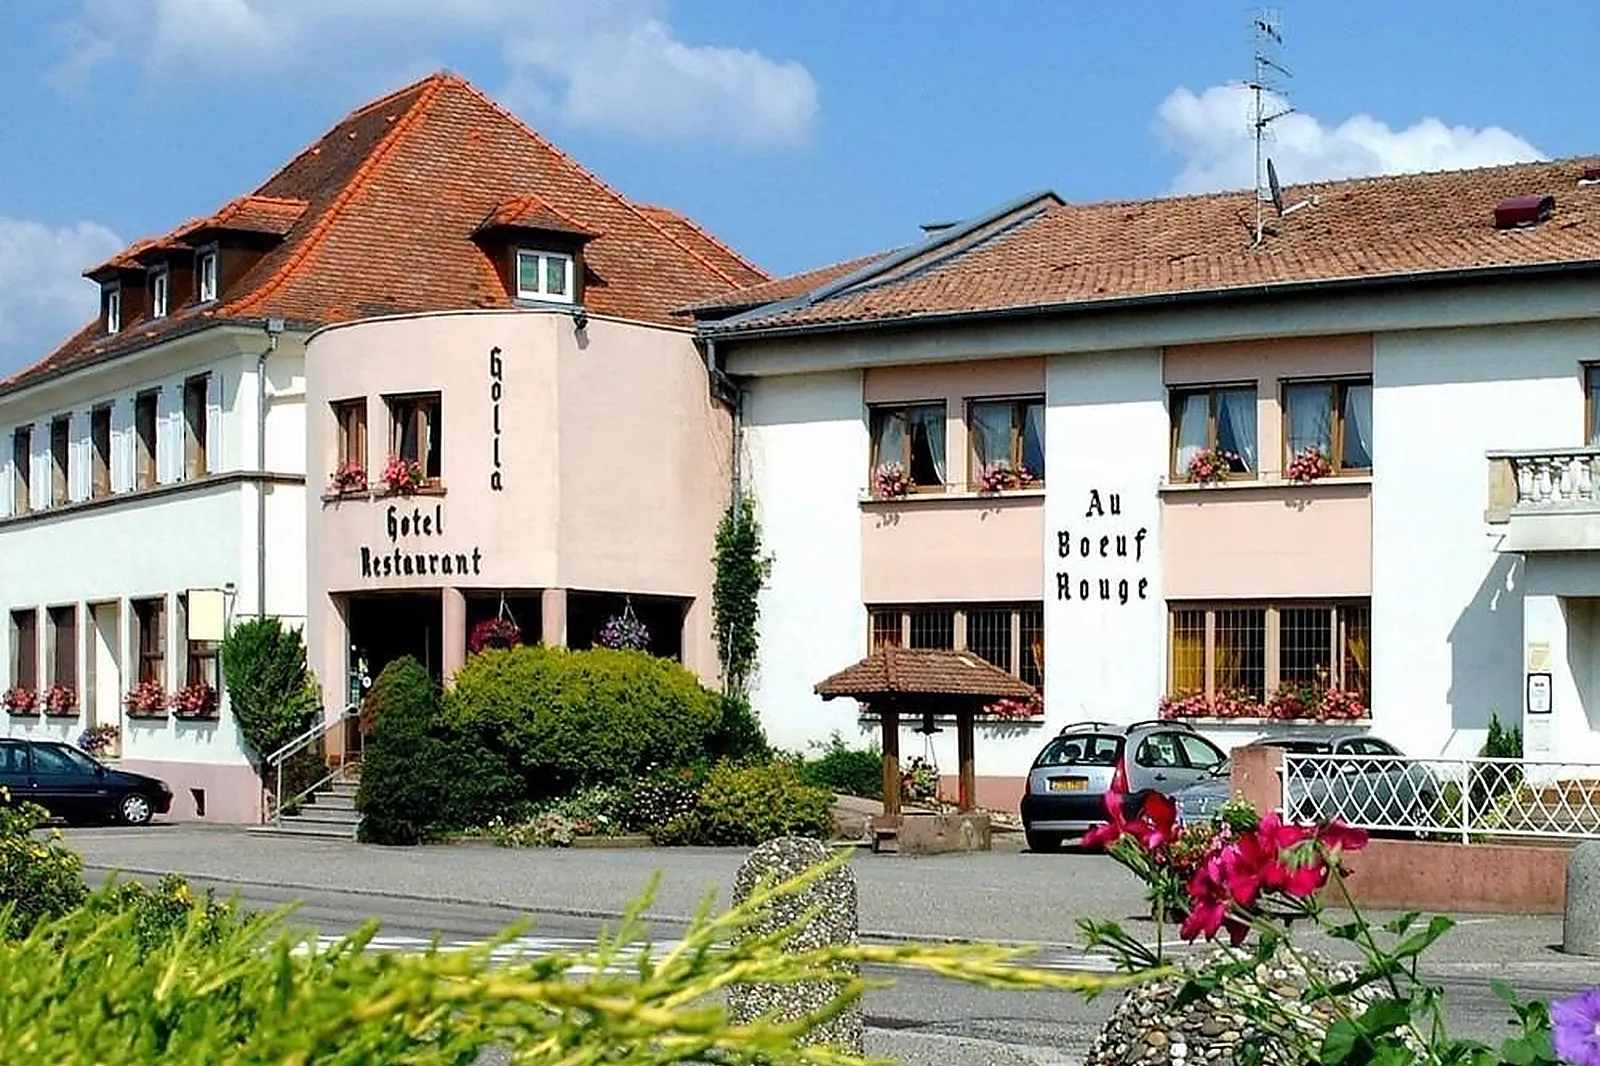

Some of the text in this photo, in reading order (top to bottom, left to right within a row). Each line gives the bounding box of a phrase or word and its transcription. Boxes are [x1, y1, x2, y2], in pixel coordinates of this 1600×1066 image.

[1085, 488, 1121, 518] Au
[1057, 527, 1148, 562] Boeuf
[360, 546, 482, 578] Restaurant
[1056, 572, 1148, 606] Rouge
